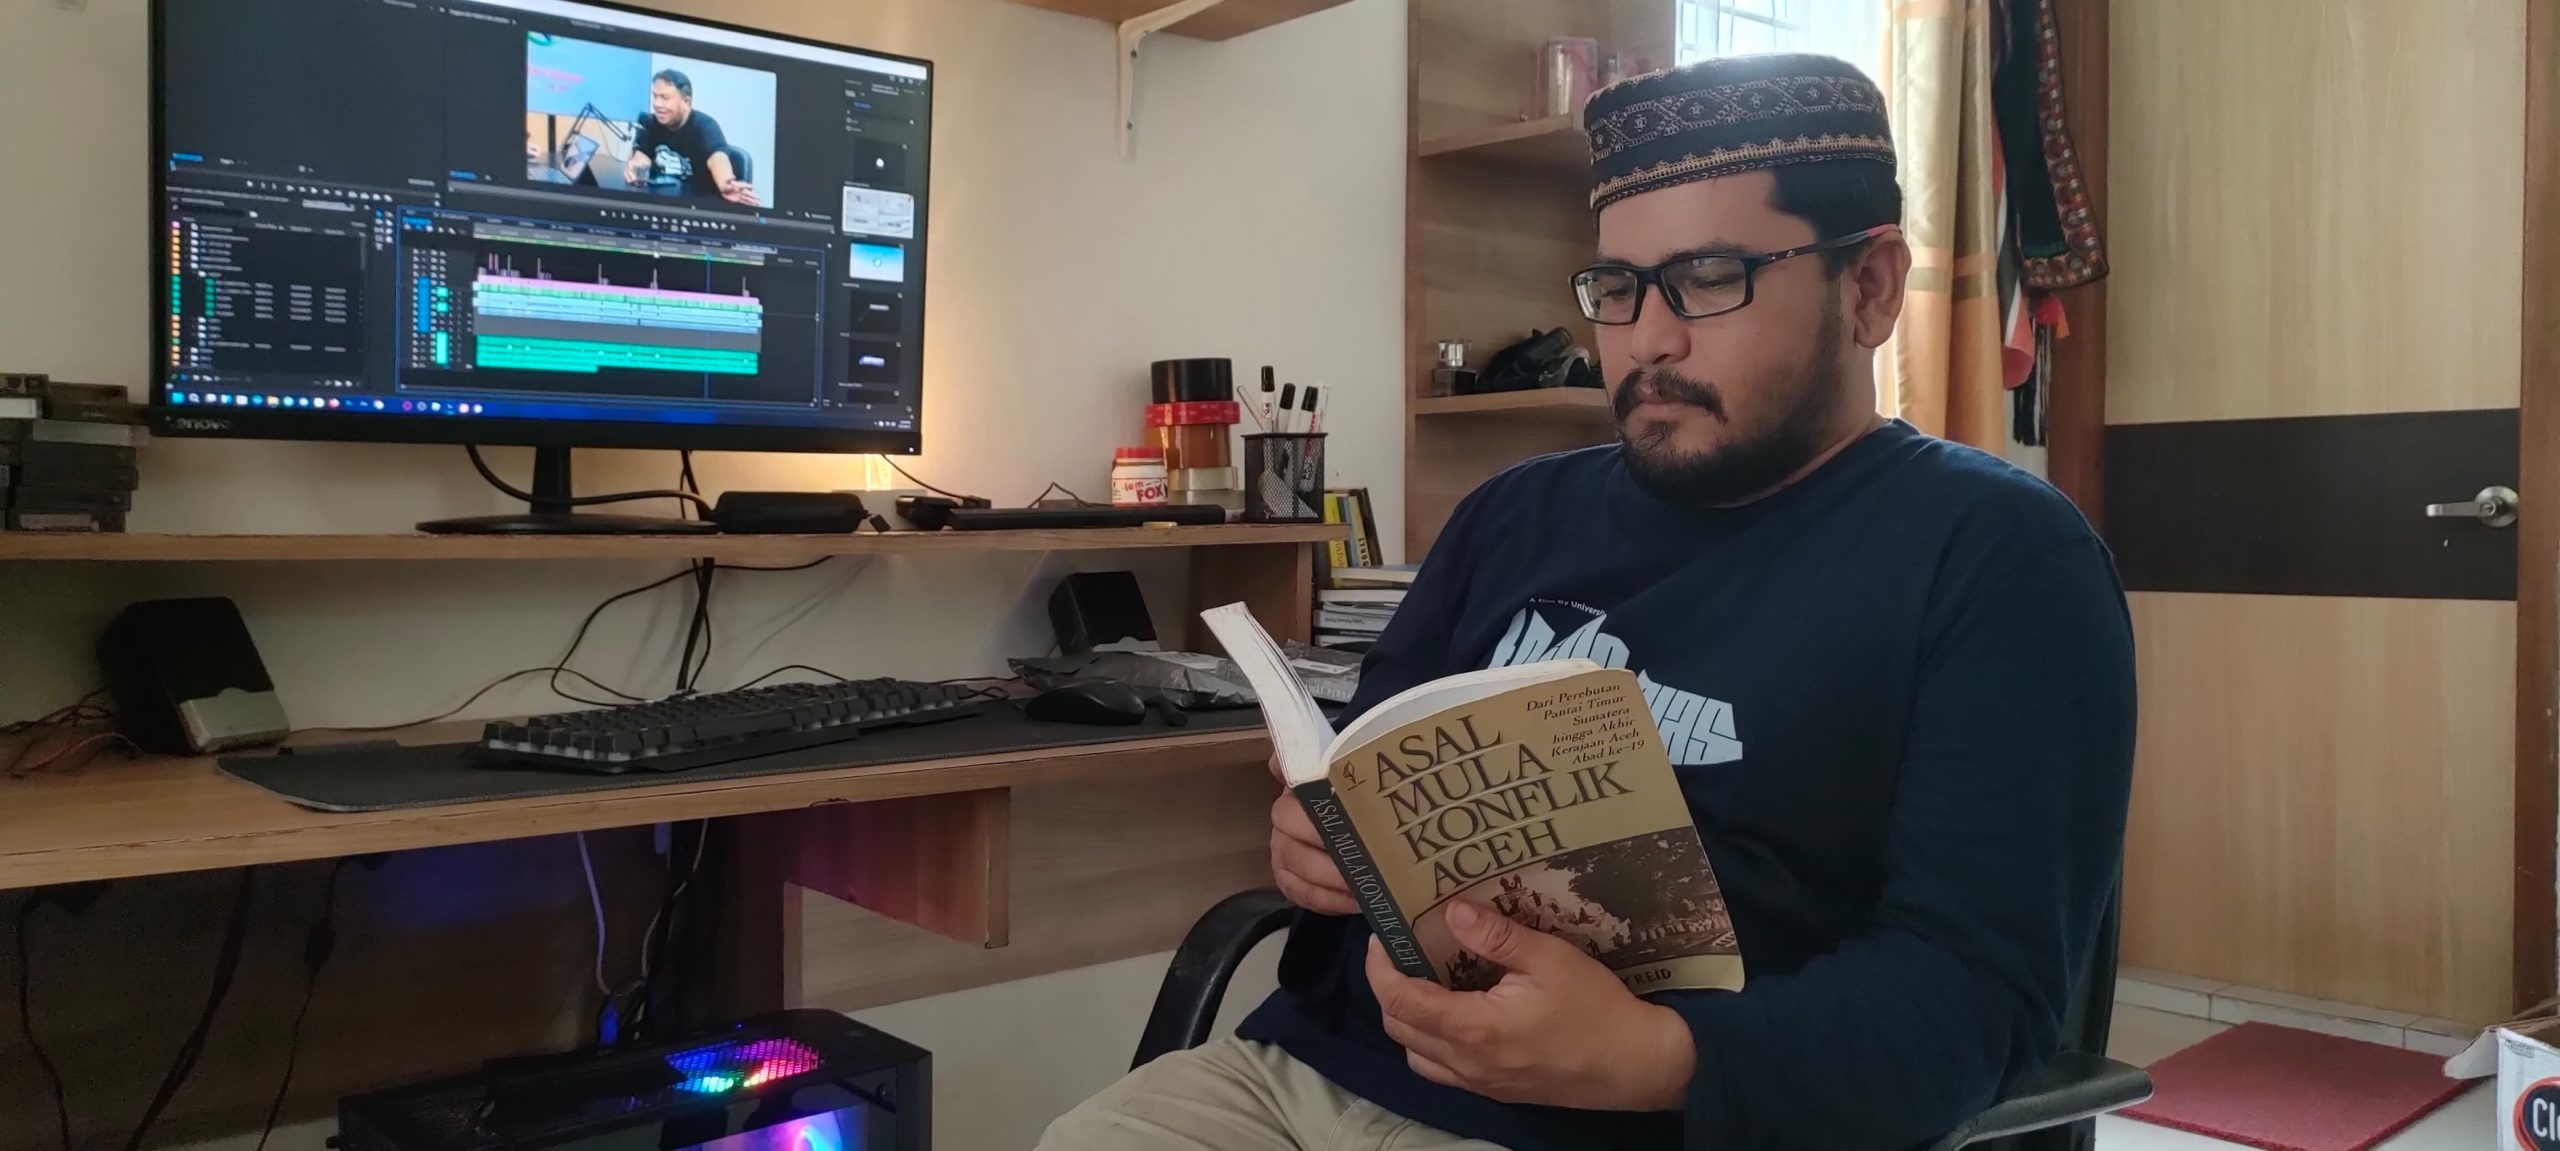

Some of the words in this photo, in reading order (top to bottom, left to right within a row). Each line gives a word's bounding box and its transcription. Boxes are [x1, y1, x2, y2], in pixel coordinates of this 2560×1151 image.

[1136, 484, 1164, 502] FOX
[1526, 696, 1554, 712] Dari
[1559, 684, 1621, 703] Perebutan
[1543, 702, 1582, 720] Pantai
[1587, 695, 1626, 709] Timur
[1553, 730, 1593, 745] hingga
[1598, 717, 1636, 733] Akhir
[1572, 707, 1630, 726] Sumatera
[1376, 714, 1504, 793] ASAL
[1551, 739, 1604, 758] Kerajaan
[1609, 728, 1639, 743] Aceh
[1572, 748, 1604, 765] Abad
[1383, 743, 1555, 830] MULA
[1399, 760, 1637, 864] KONFLIK
[1433, 818, 1573, 899] ACEH
[1310, 797, 1345, 832] ASAL
[1331, 832, 1368, 874] MULA
[1353, 874, 1402, 933] KONFLIK
[1386, 934, 1422, 967] ACEH
[1635, 968, 1672, 985] REID
[2532, 1097, 2560, 1142] Cl
